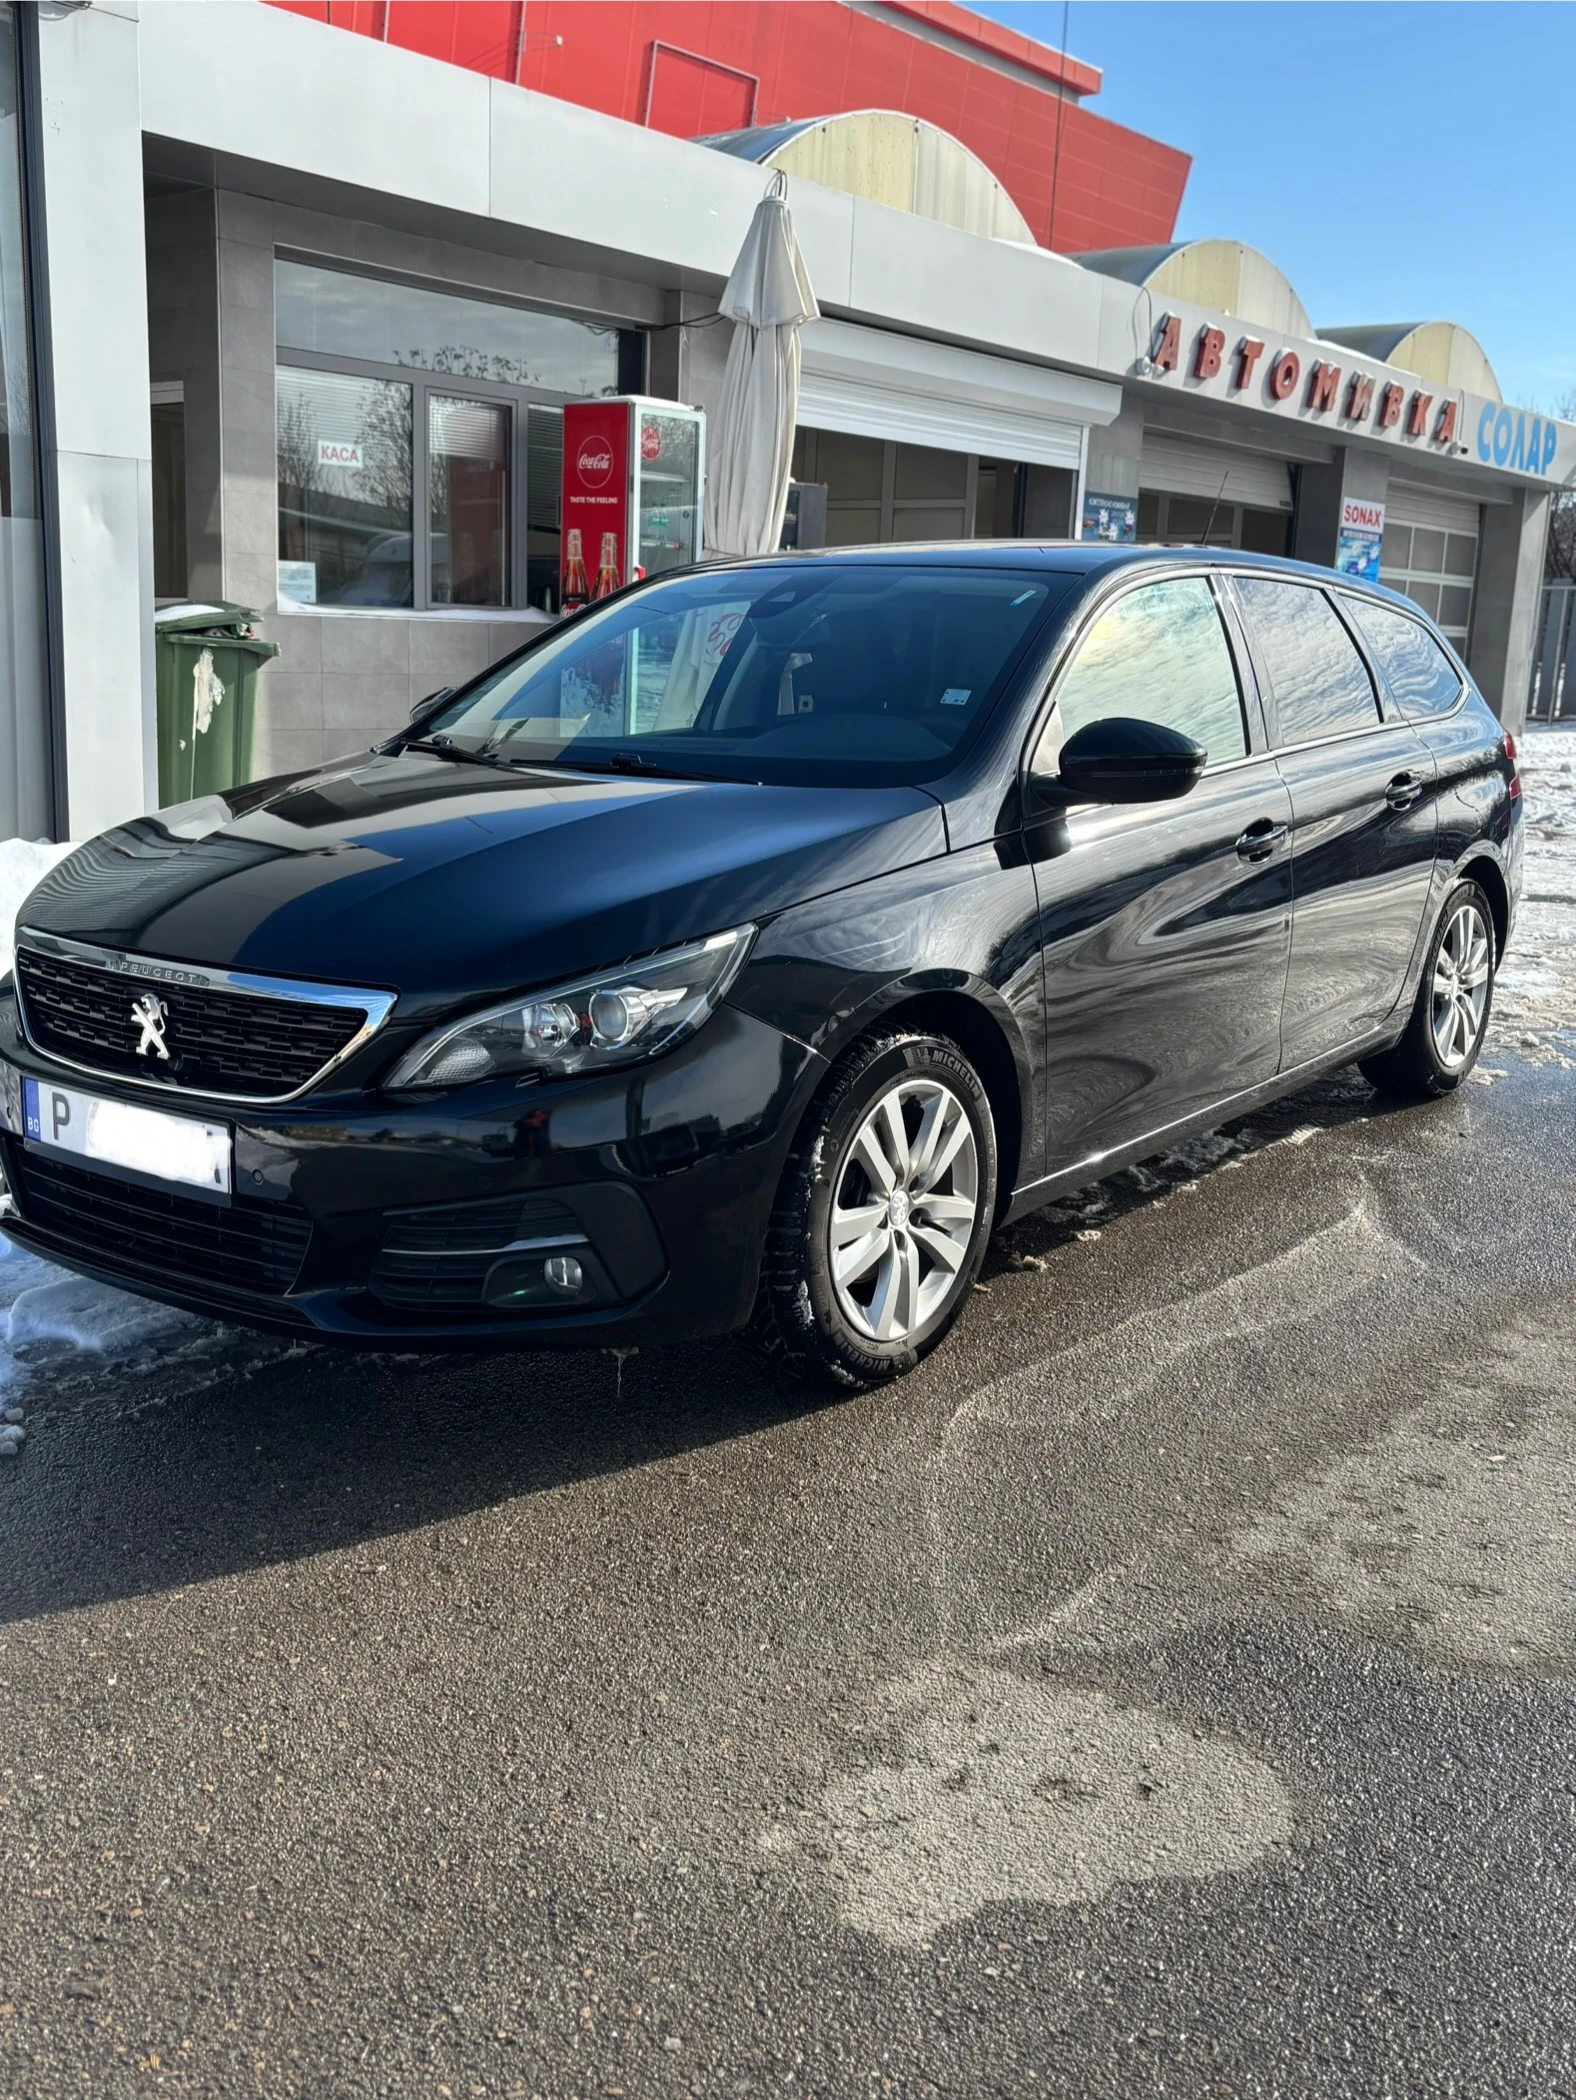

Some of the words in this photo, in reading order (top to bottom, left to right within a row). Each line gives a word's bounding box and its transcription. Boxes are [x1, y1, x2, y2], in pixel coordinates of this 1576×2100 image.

[1154, 312, 1457, 442] АВТОМИВКА
[1477, 400, 1557, 477] СОЛАР
[321, 445, 359, 463] КАСА
[1344, 505, 1381, 528] SONAX
[120, 961, 197, 983] PEUGEOT
[932, 1050, 981, 1098] MICHELIN
[27, 1116, 40, 1133] BG
